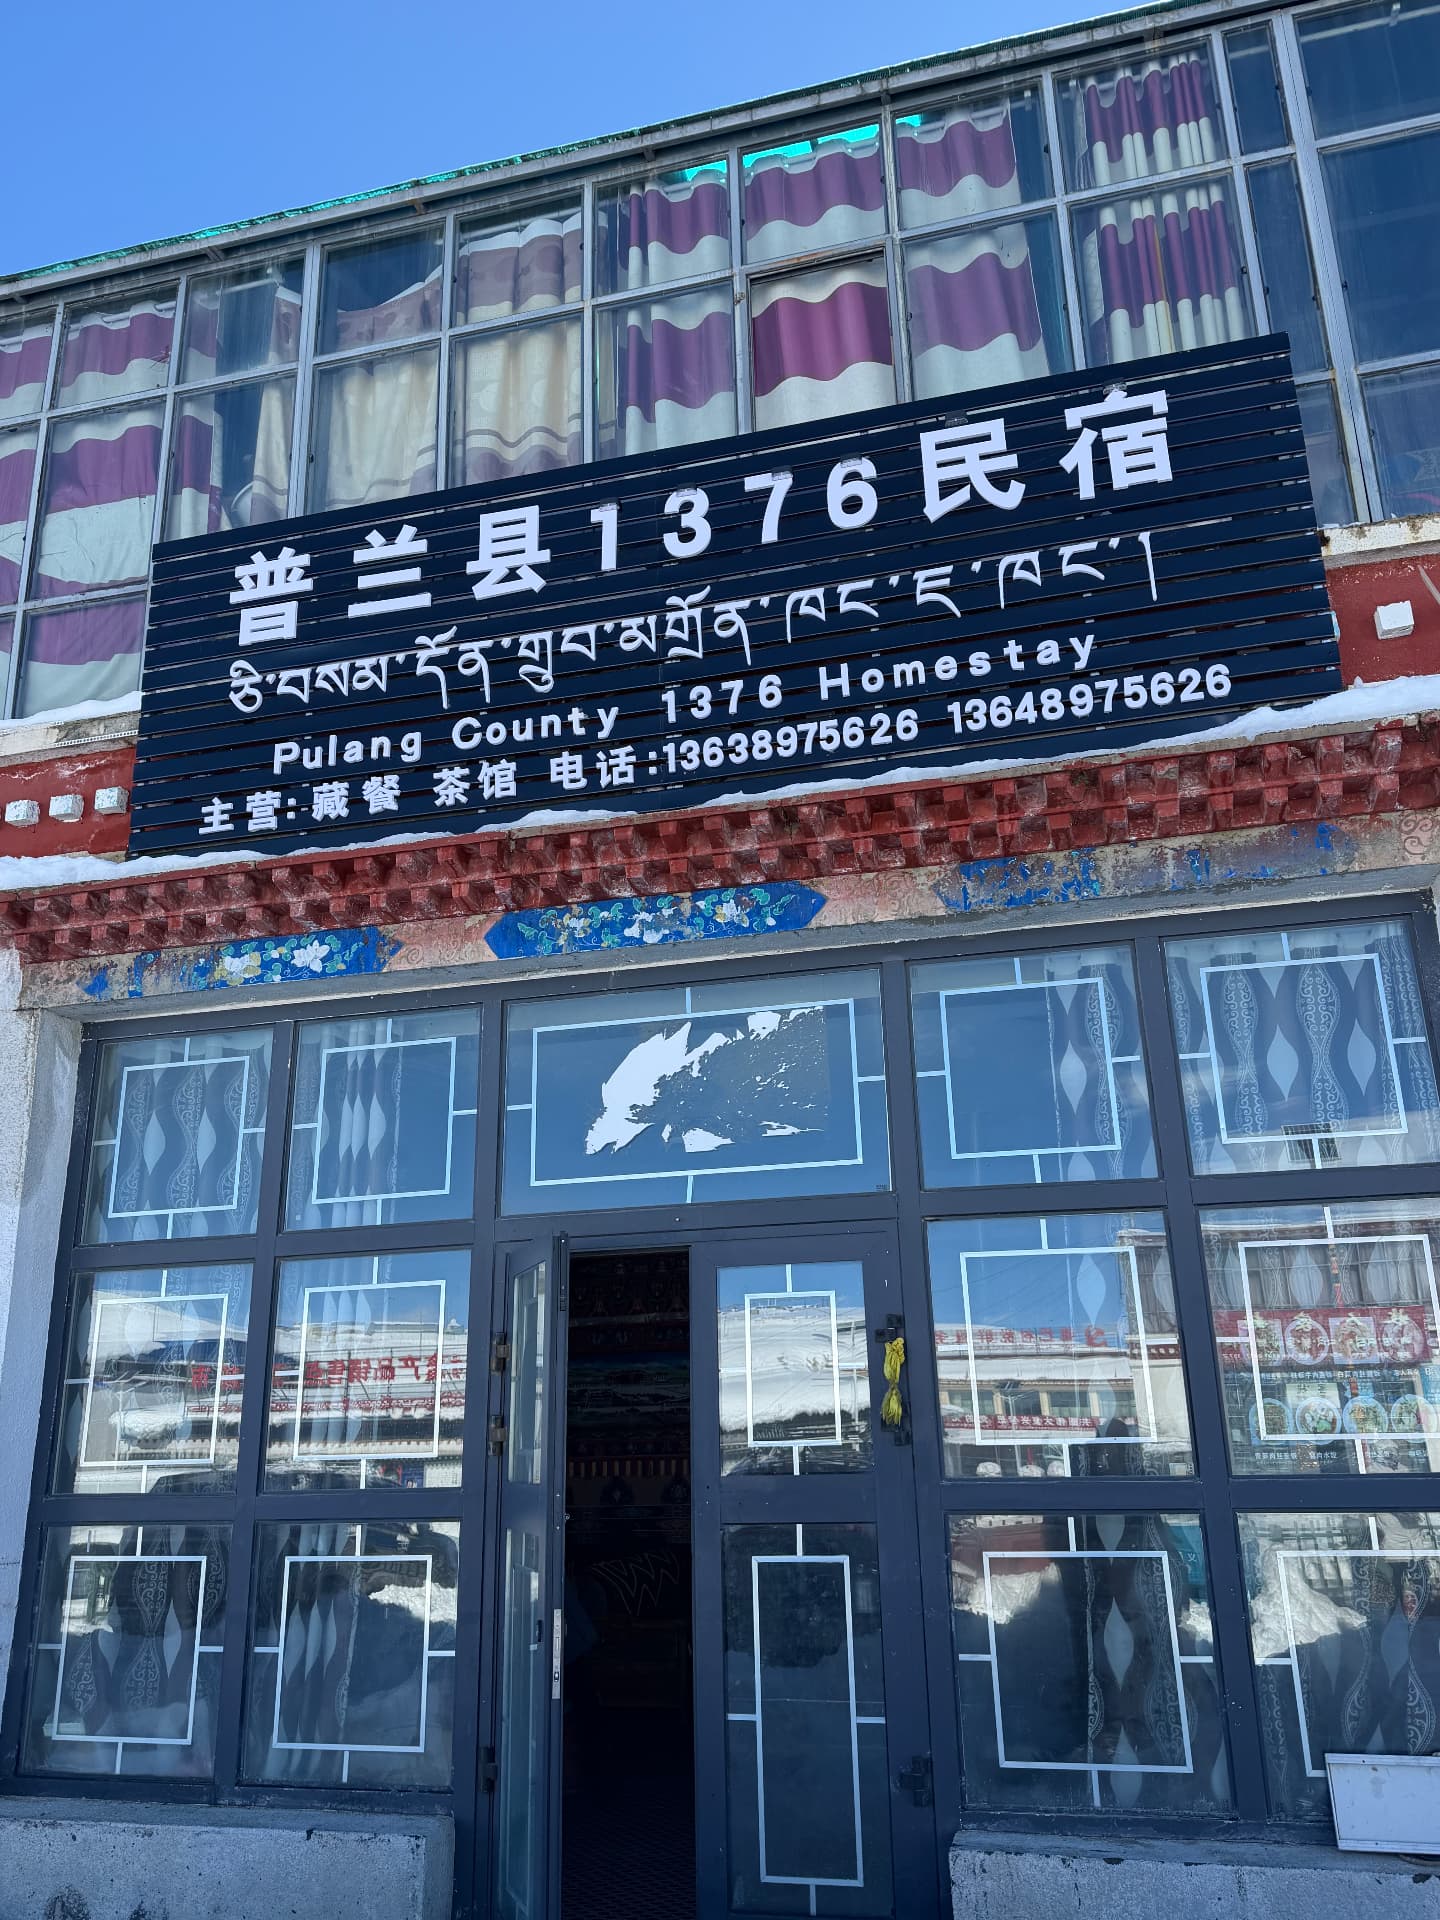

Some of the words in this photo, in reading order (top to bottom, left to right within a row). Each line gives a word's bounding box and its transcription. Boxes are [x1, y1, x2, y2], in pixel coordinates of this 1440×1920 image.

[273, 728, 422, 777] Pulang
[452, 706, 618, 751] County
[660, 673, 783, 725] 1376
[819, 633, 1095, 701] Homestay
[433, 758, 517, 806] 茶馆
[946, 662, 1232, 735] 13648975626
